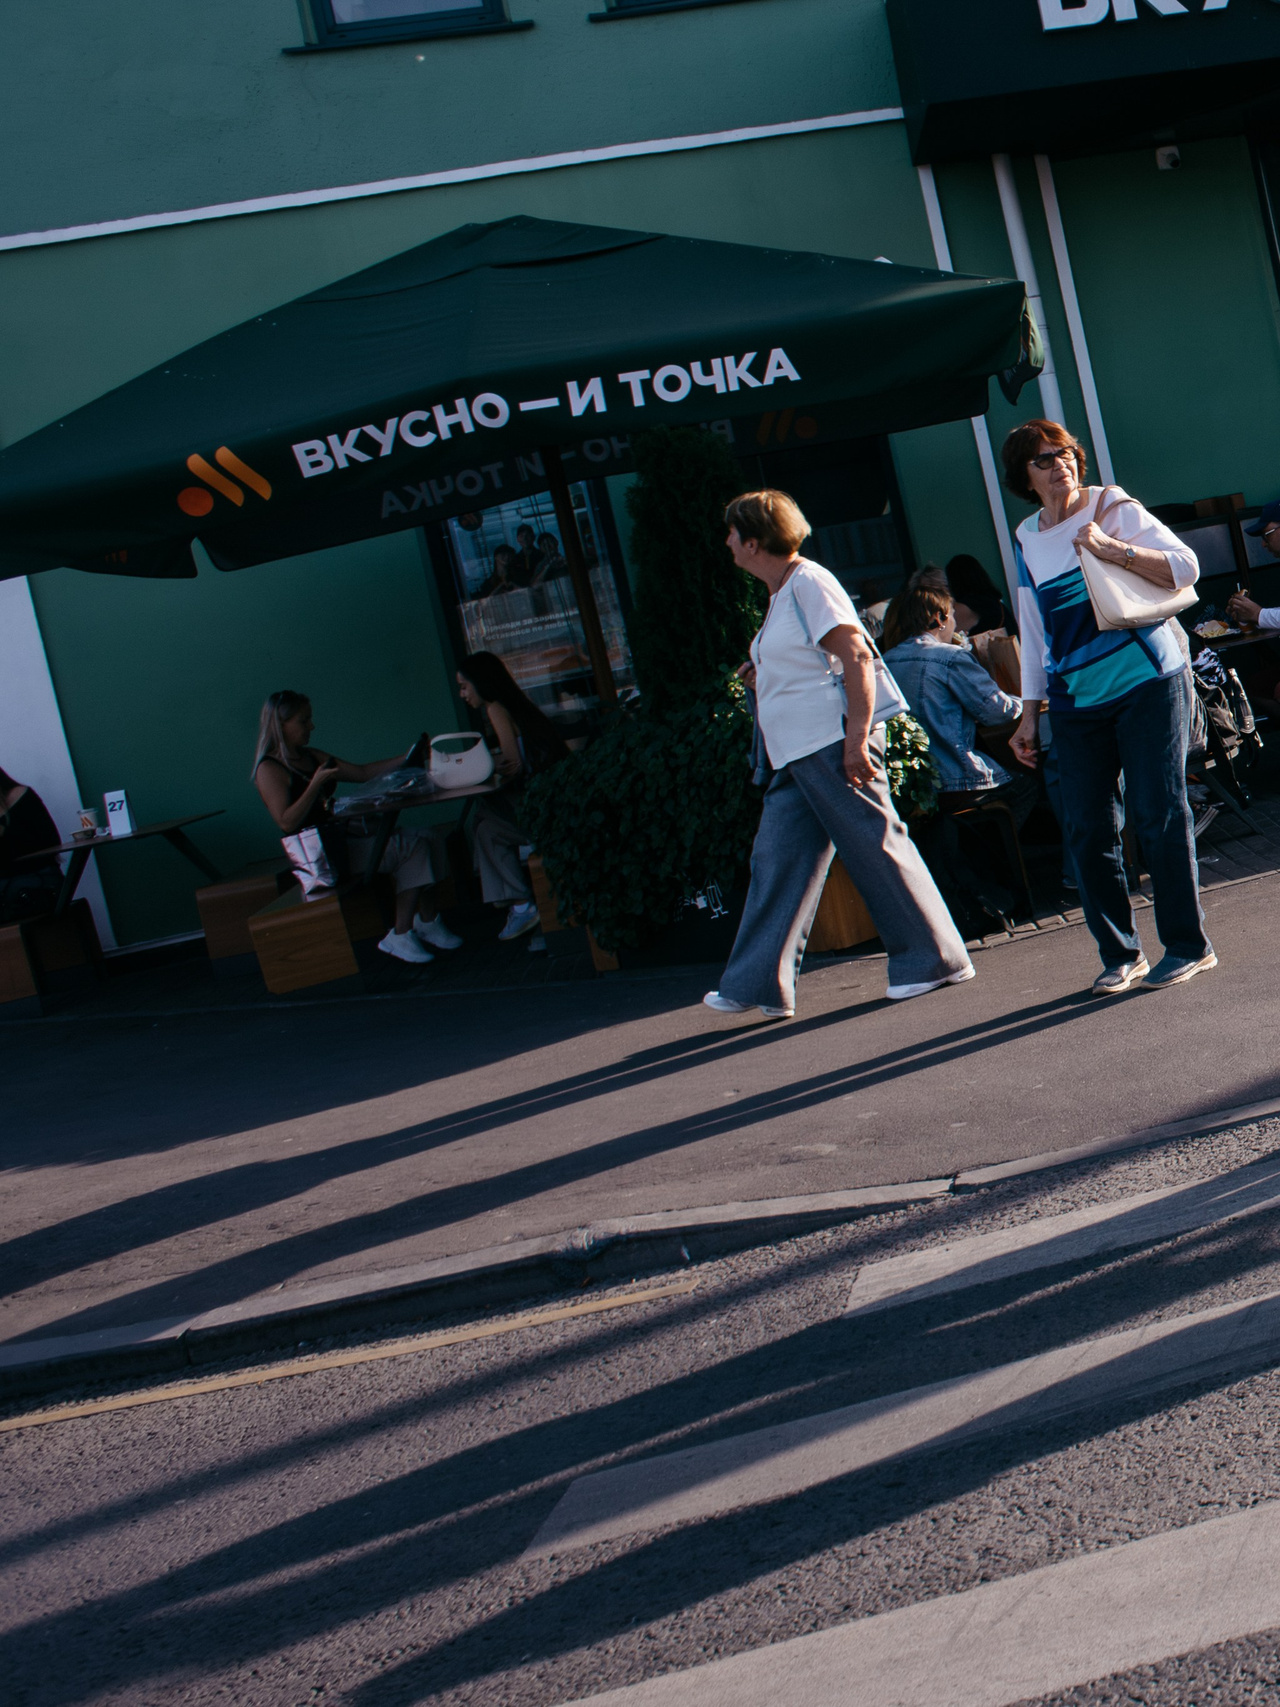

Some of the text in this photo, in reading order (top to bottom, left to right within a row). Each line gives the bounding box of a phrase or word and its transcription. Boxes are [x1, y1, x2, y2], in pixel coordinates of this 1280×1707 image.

[291, 392, 510, 479] ВКУСНО
[566, 376, 607, 417] И
[617, 347, 802, 407] ТОЧКА
[108, 799, 125, 813] 27
